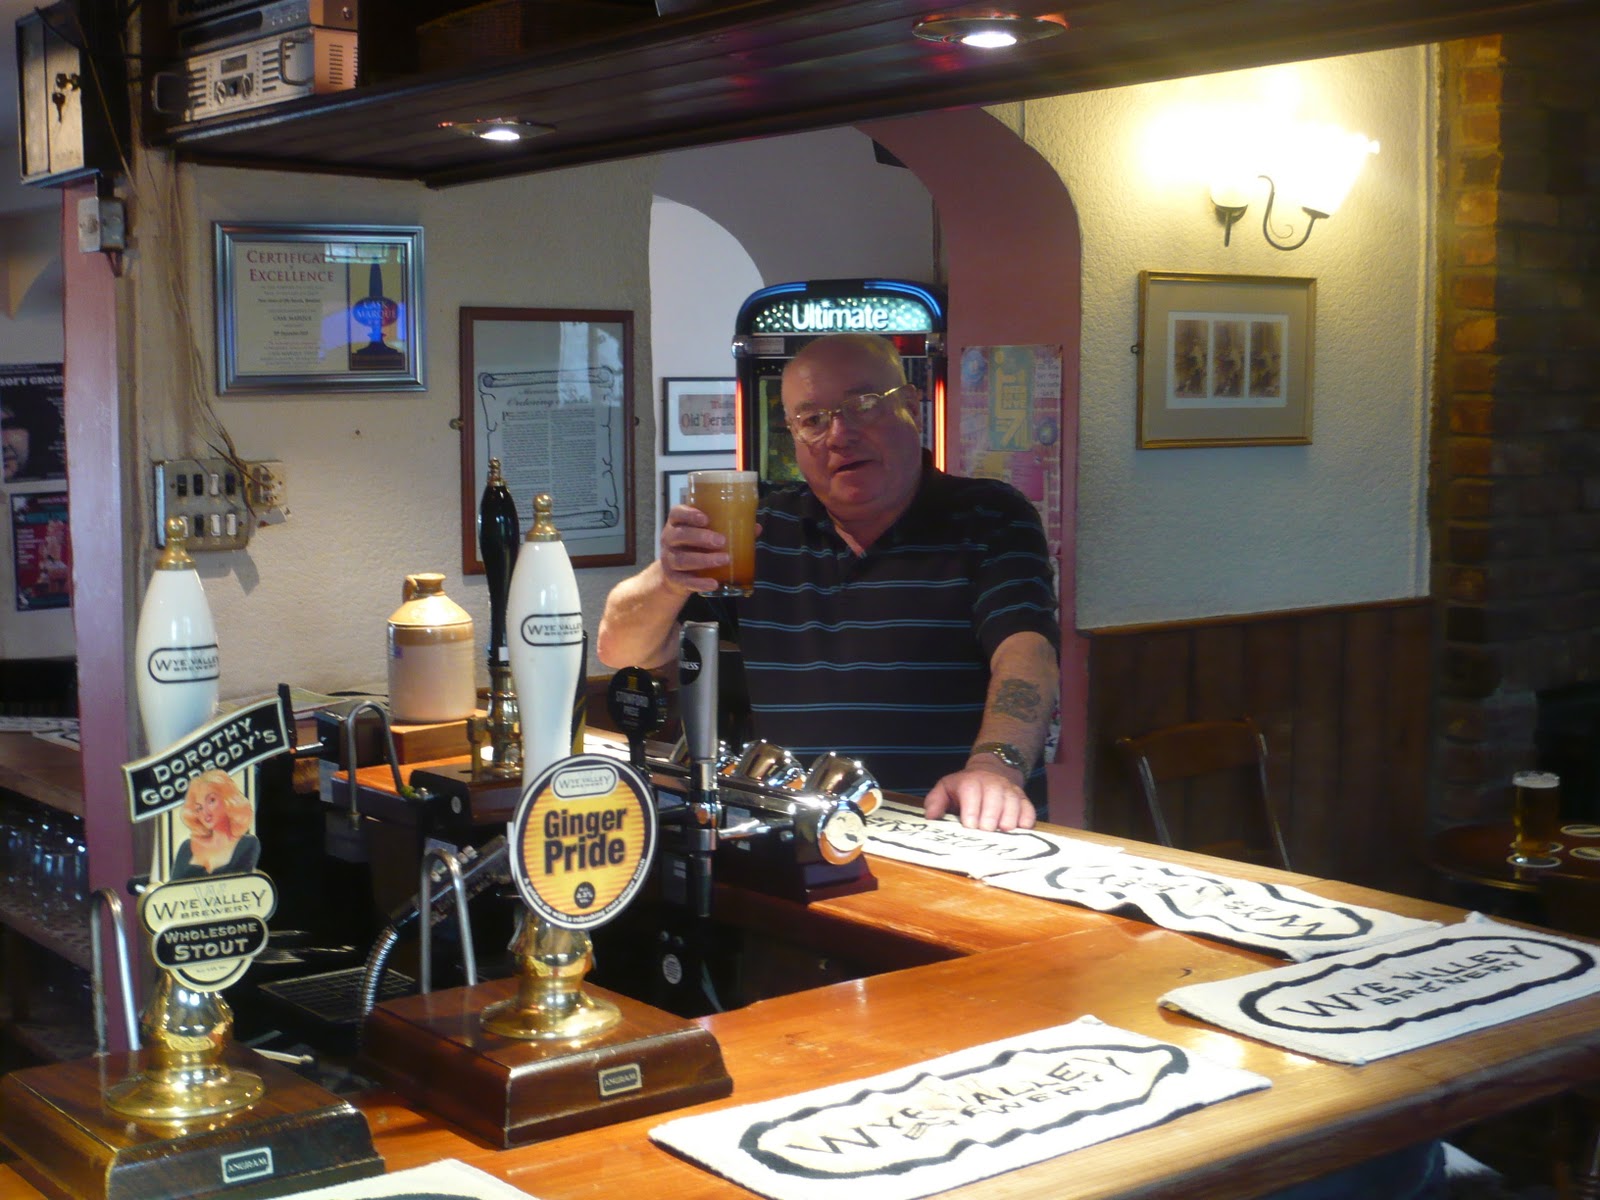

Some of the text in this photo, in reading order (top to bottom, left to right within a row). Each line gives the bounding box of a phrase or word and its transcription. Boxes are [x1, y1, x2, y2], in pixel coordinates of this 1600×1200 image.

[249, 268, 335, 282] EXCELLENCE
[791, 300, 889, 331] Ultimate
[154, 658, 188, 672] WYE
[152, 717, 253, 784] DOROTHY
[543, 807, 628, 840] Ginger
[544, 833, 626, 875] Pride
[152, 889, 267, 921] WYE VALLEY
[181, 904, 252, 920] BREWERY
[163, 922, 258, 944] WHOLESOME
[174, 937, 249, 961] STOUT
[1276, 944, 1542, 1018] WYE VALLEY
[1372, 959, 1525, 1007] BREWERY
[785, 1055, 1134, 1155] WYE VALLEY
